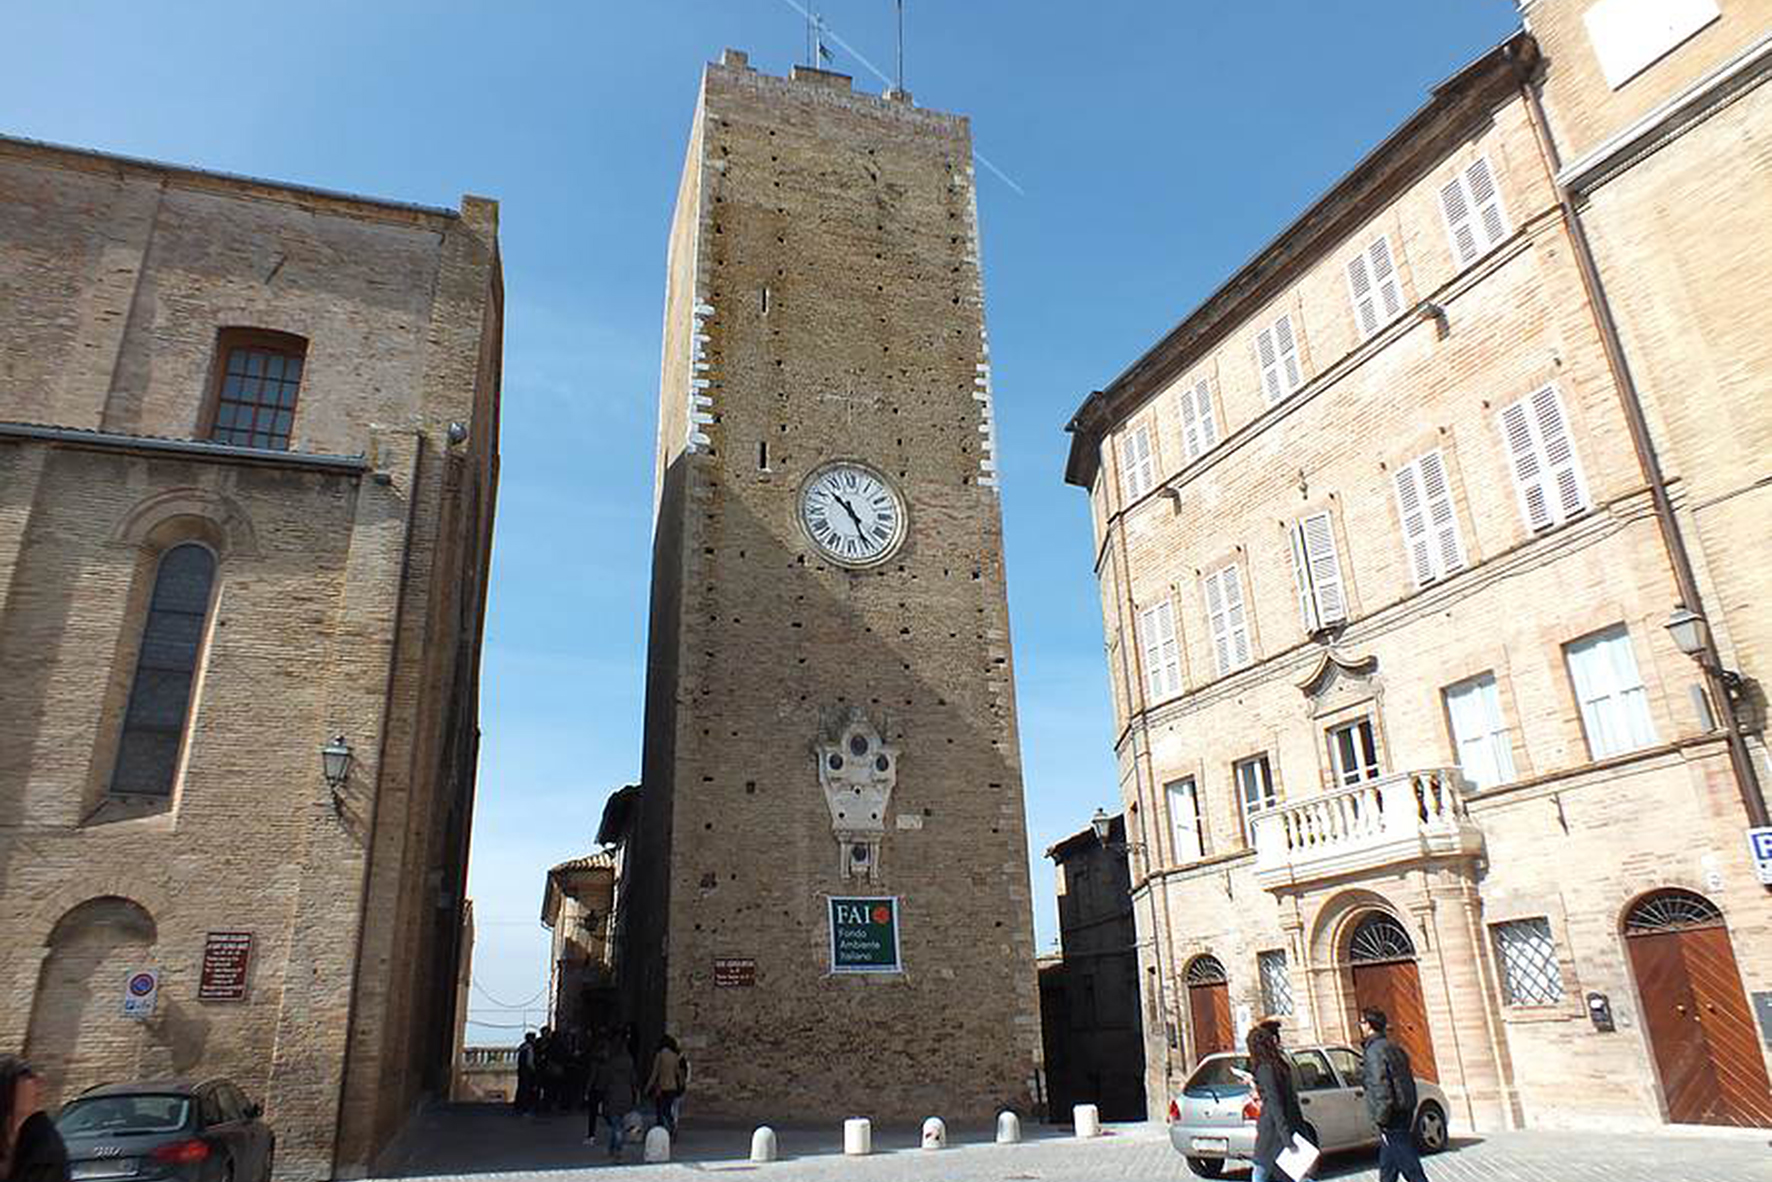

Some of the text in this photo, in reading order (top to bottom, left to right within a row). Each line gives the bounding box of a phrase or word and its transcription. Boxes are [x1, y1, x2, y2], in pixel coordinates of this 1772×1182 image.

[837, 905, 870, 924] FAI
[838, 927, 868, 938] Fondo
[840, 940, 881, 950] Ambiente
[840, 950, 872, 961] Italiano
